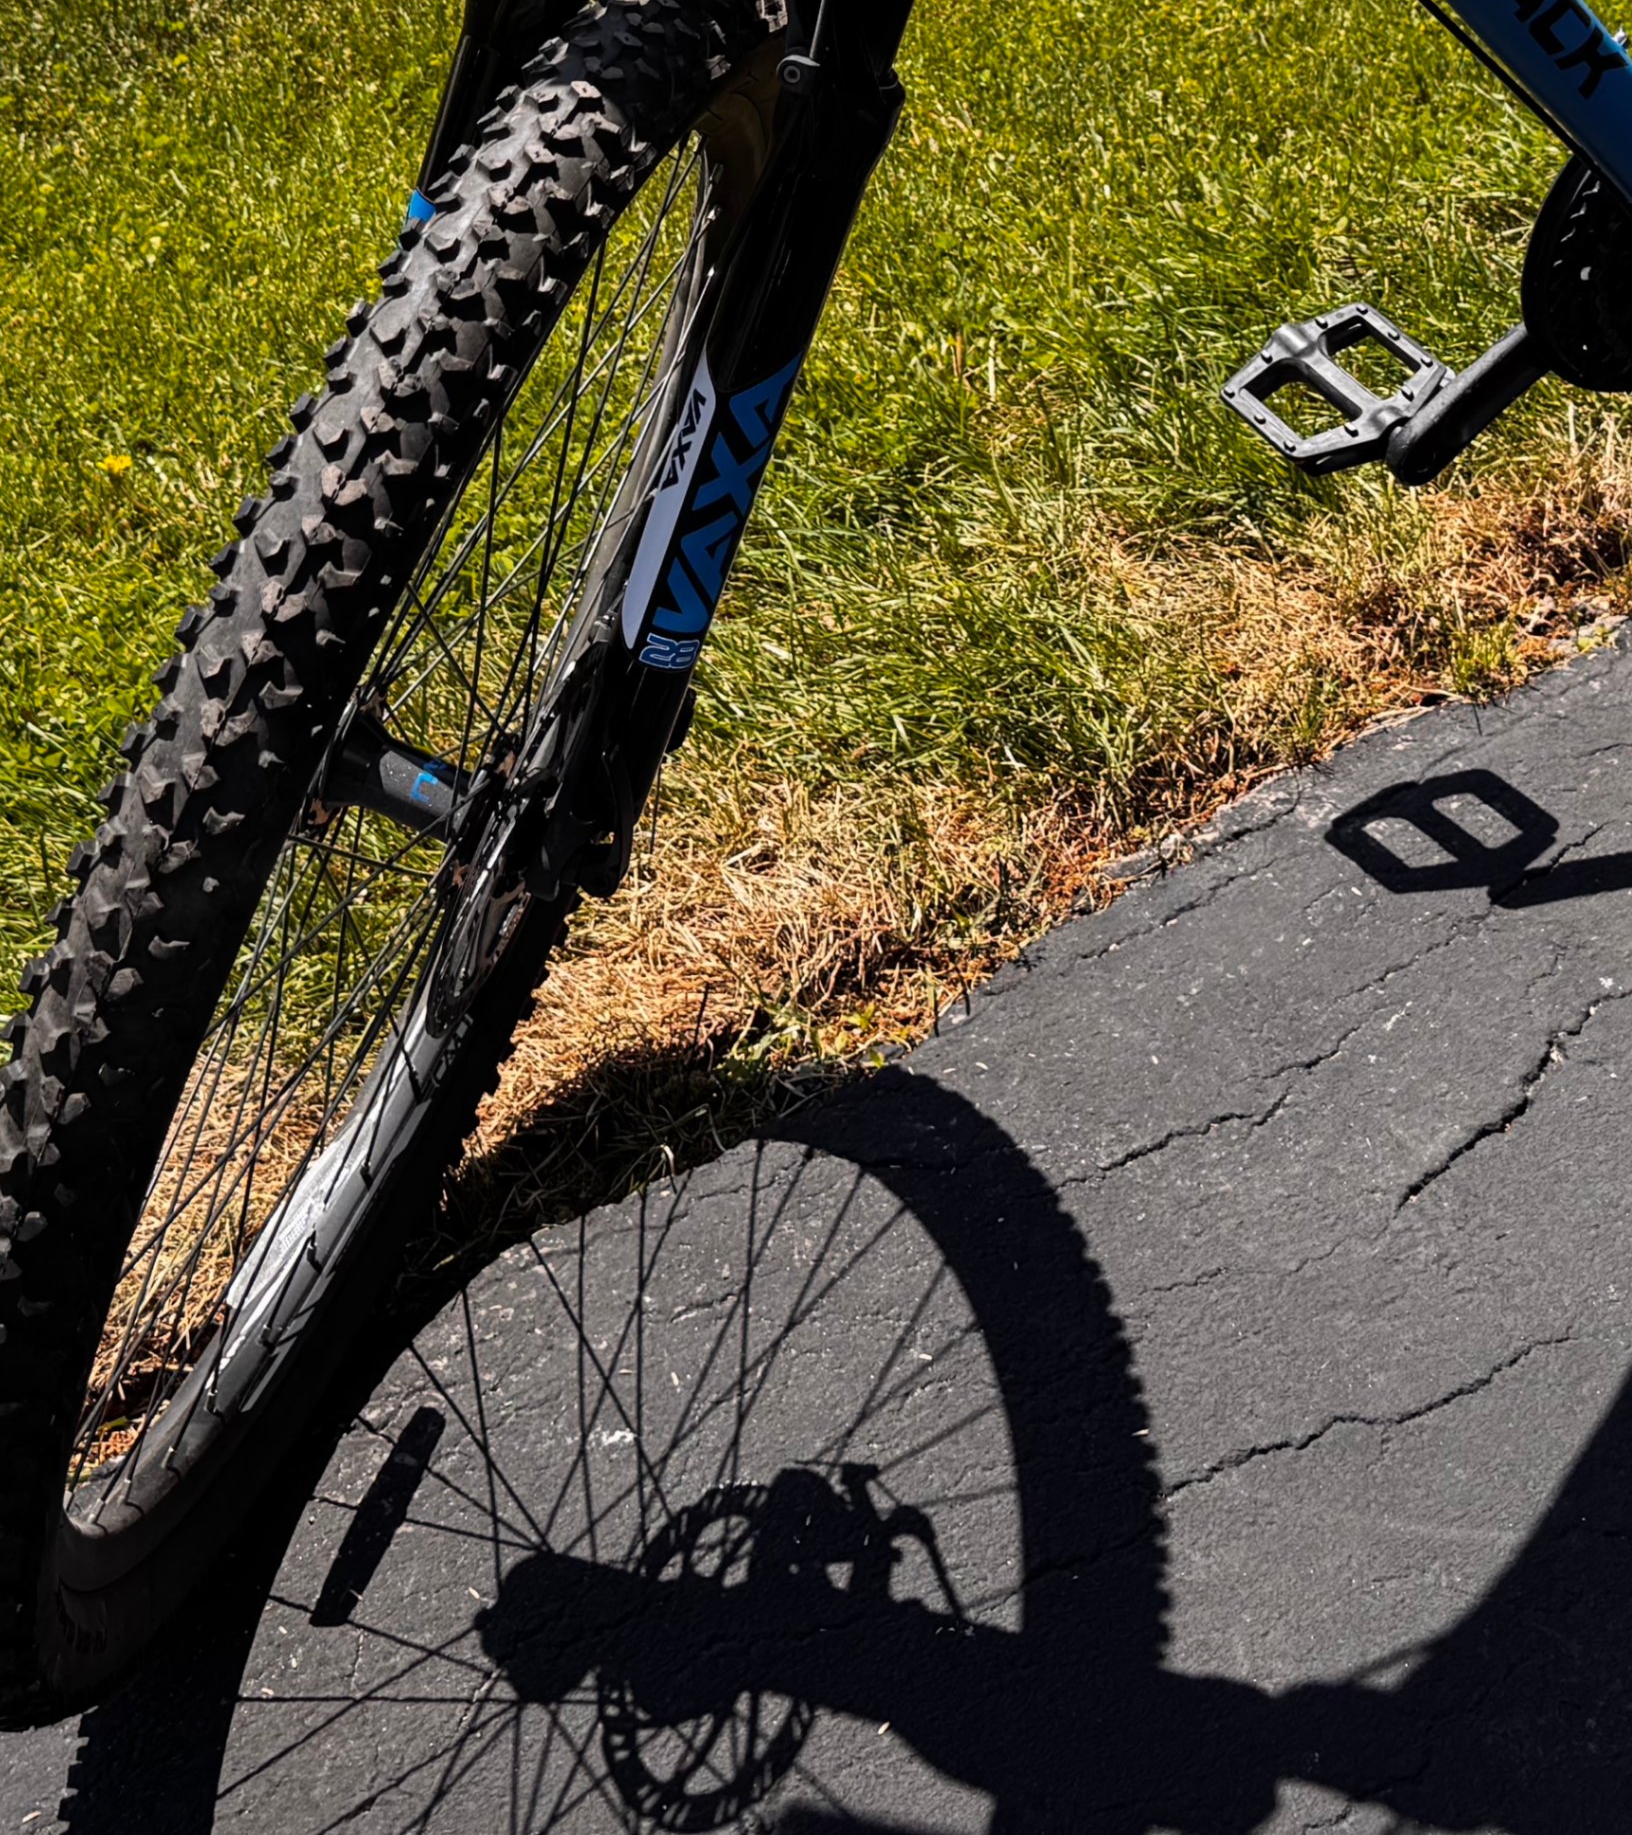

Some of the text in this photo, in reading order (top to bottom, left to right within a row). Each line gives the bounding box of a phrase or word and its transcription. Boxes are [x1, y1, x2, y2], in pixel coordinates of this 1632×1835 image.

[652, 351, 803, 633] VAXA
[661, 388, 707, 492] VAXA
[638, 633, 701, 671] 28
